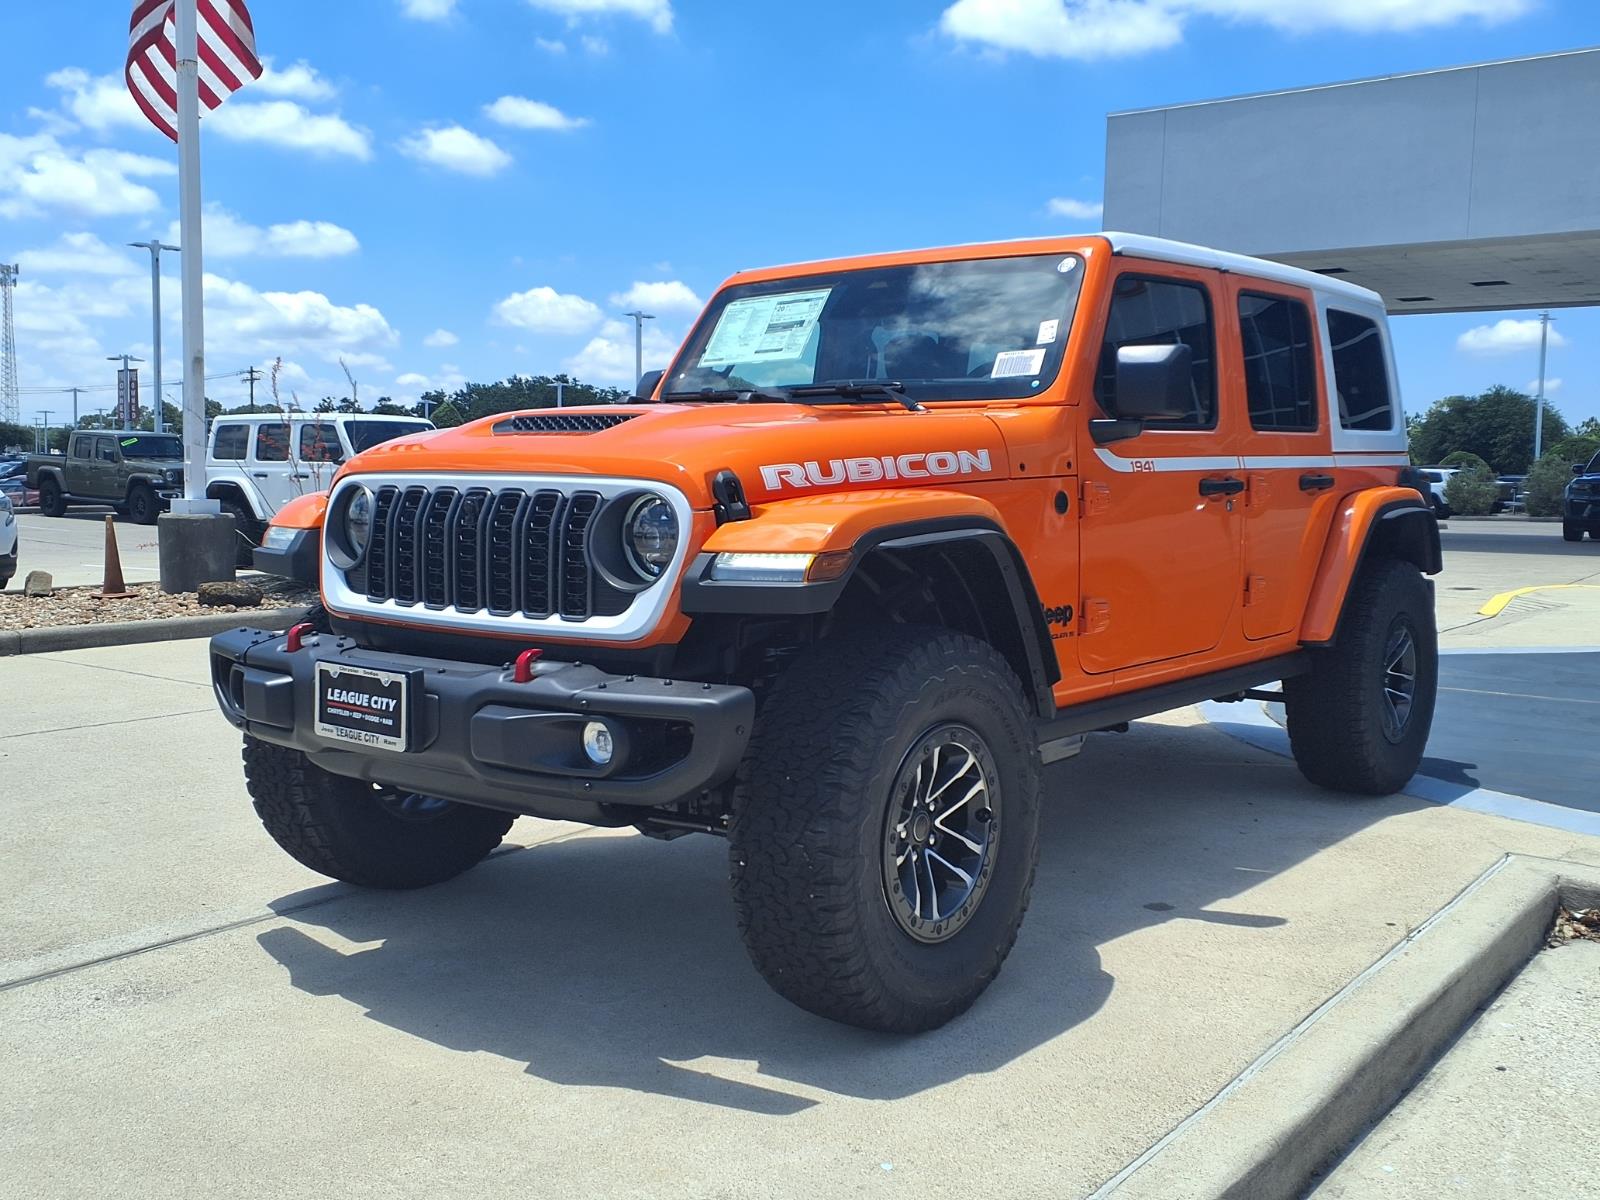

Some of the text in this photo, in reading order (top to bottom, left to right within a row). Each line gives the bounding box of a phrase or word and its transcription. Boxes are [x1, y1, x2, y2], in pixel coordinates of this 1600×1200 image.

[759, 449, 992, 490] RUBICON
[1130, 460, 1155, 472] 1941
[327, 688, 397, 711] LEAGUE CITY
[336, 727, 362, 741] LEAGUE
[364, 733, 379, 744] CITY
